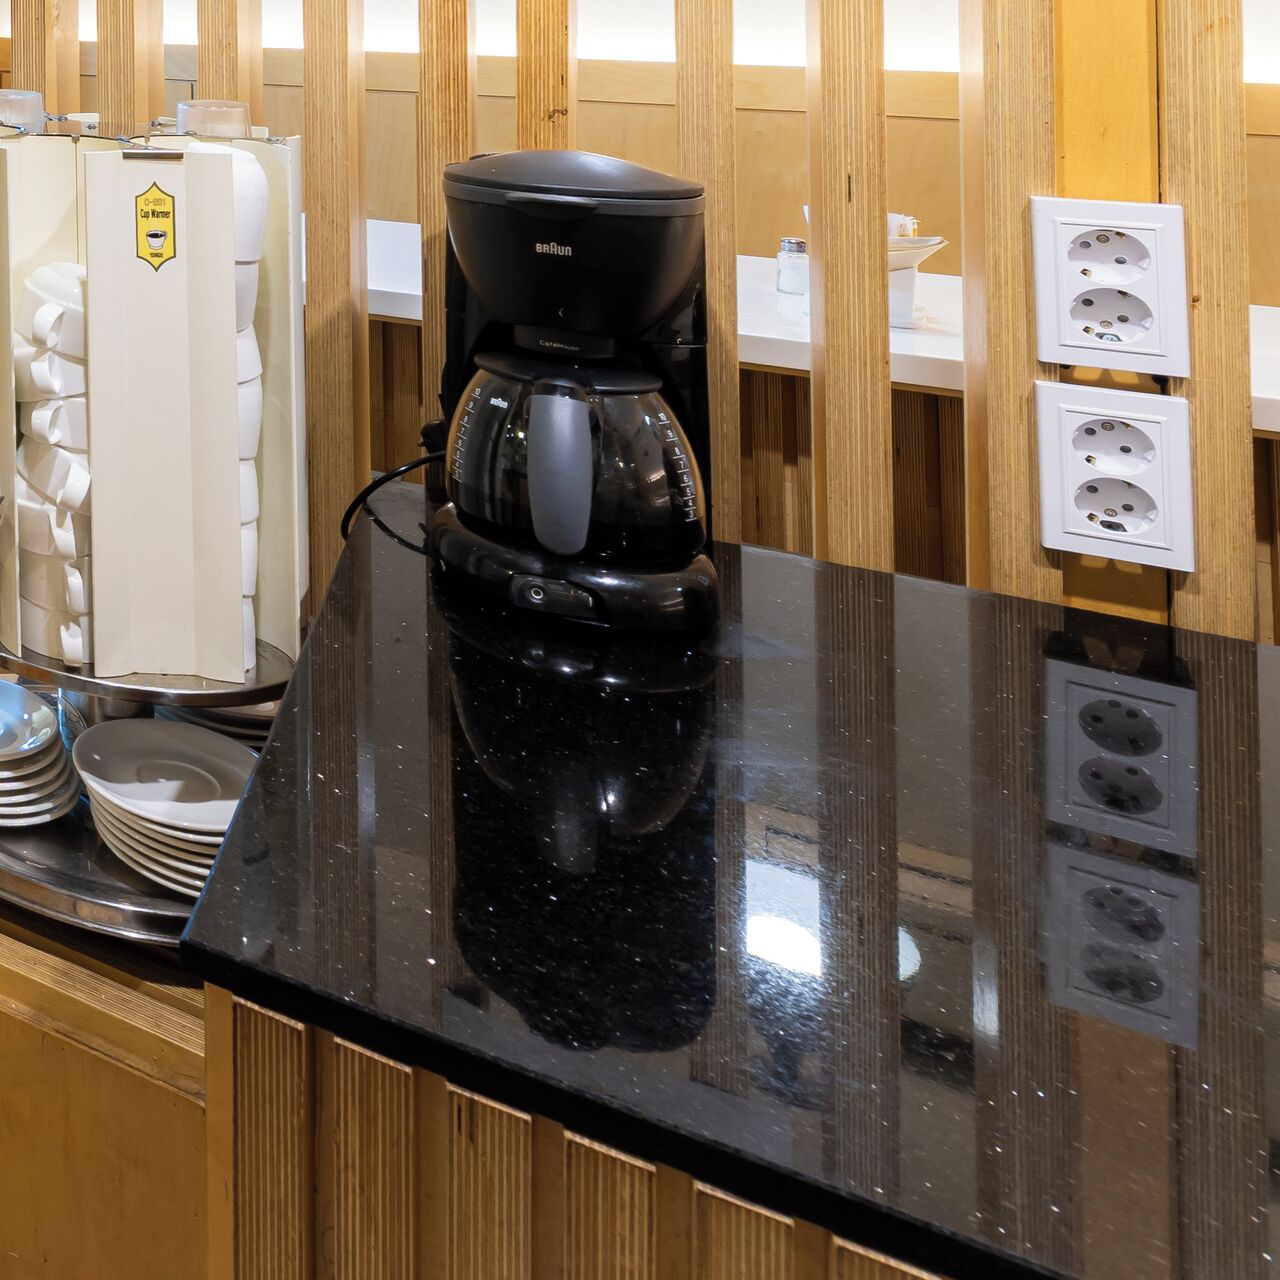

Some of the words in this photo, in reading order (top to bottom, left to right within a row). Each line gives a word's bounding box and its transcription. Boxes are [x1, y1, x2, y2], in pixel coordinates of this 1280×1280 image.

[140, 208, 150, 221] Cup
[151, 209, 171, 219] Warmer
[535, 242, 572, 256] BRAUN
